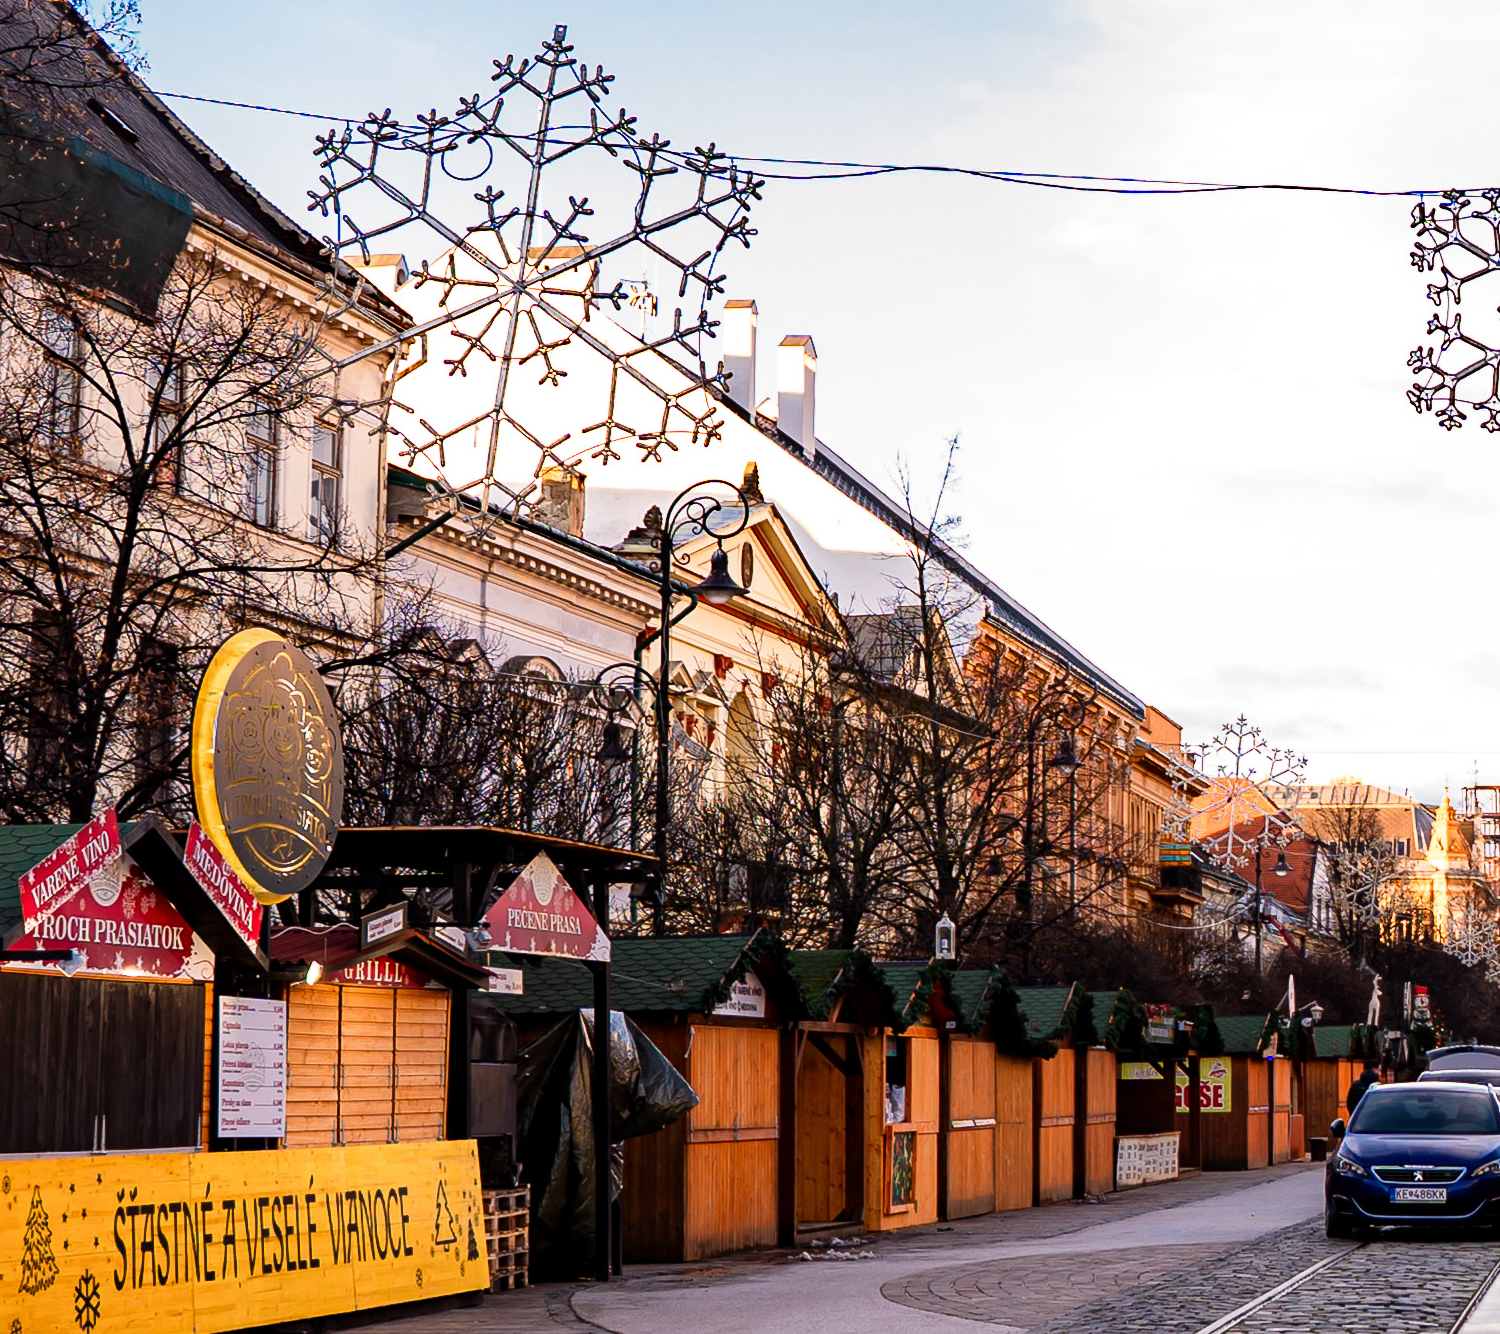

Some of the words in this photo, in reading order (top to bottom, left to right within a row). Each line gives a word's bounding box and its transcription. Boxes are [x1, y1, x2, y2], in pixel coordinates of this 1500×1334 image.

[81, 830, 110, 868] VÍNO
[194, 839, 253, 932] MEDOVINA
[33, 914, 91, 943] TROCH
[94, 920, 186, 951] PRASIATOK
[507, 905, 549, 932] PEČENÉ
[550, 914, 582, 935] PRASA
[113, 1181, 216, 1292] ŠŤASTNÉ
[222, 1199, 238, 1280] A
[243, 1174, 321, 1276] VESELÉ
[326, 1186, 414, 1266] VIANOCE
